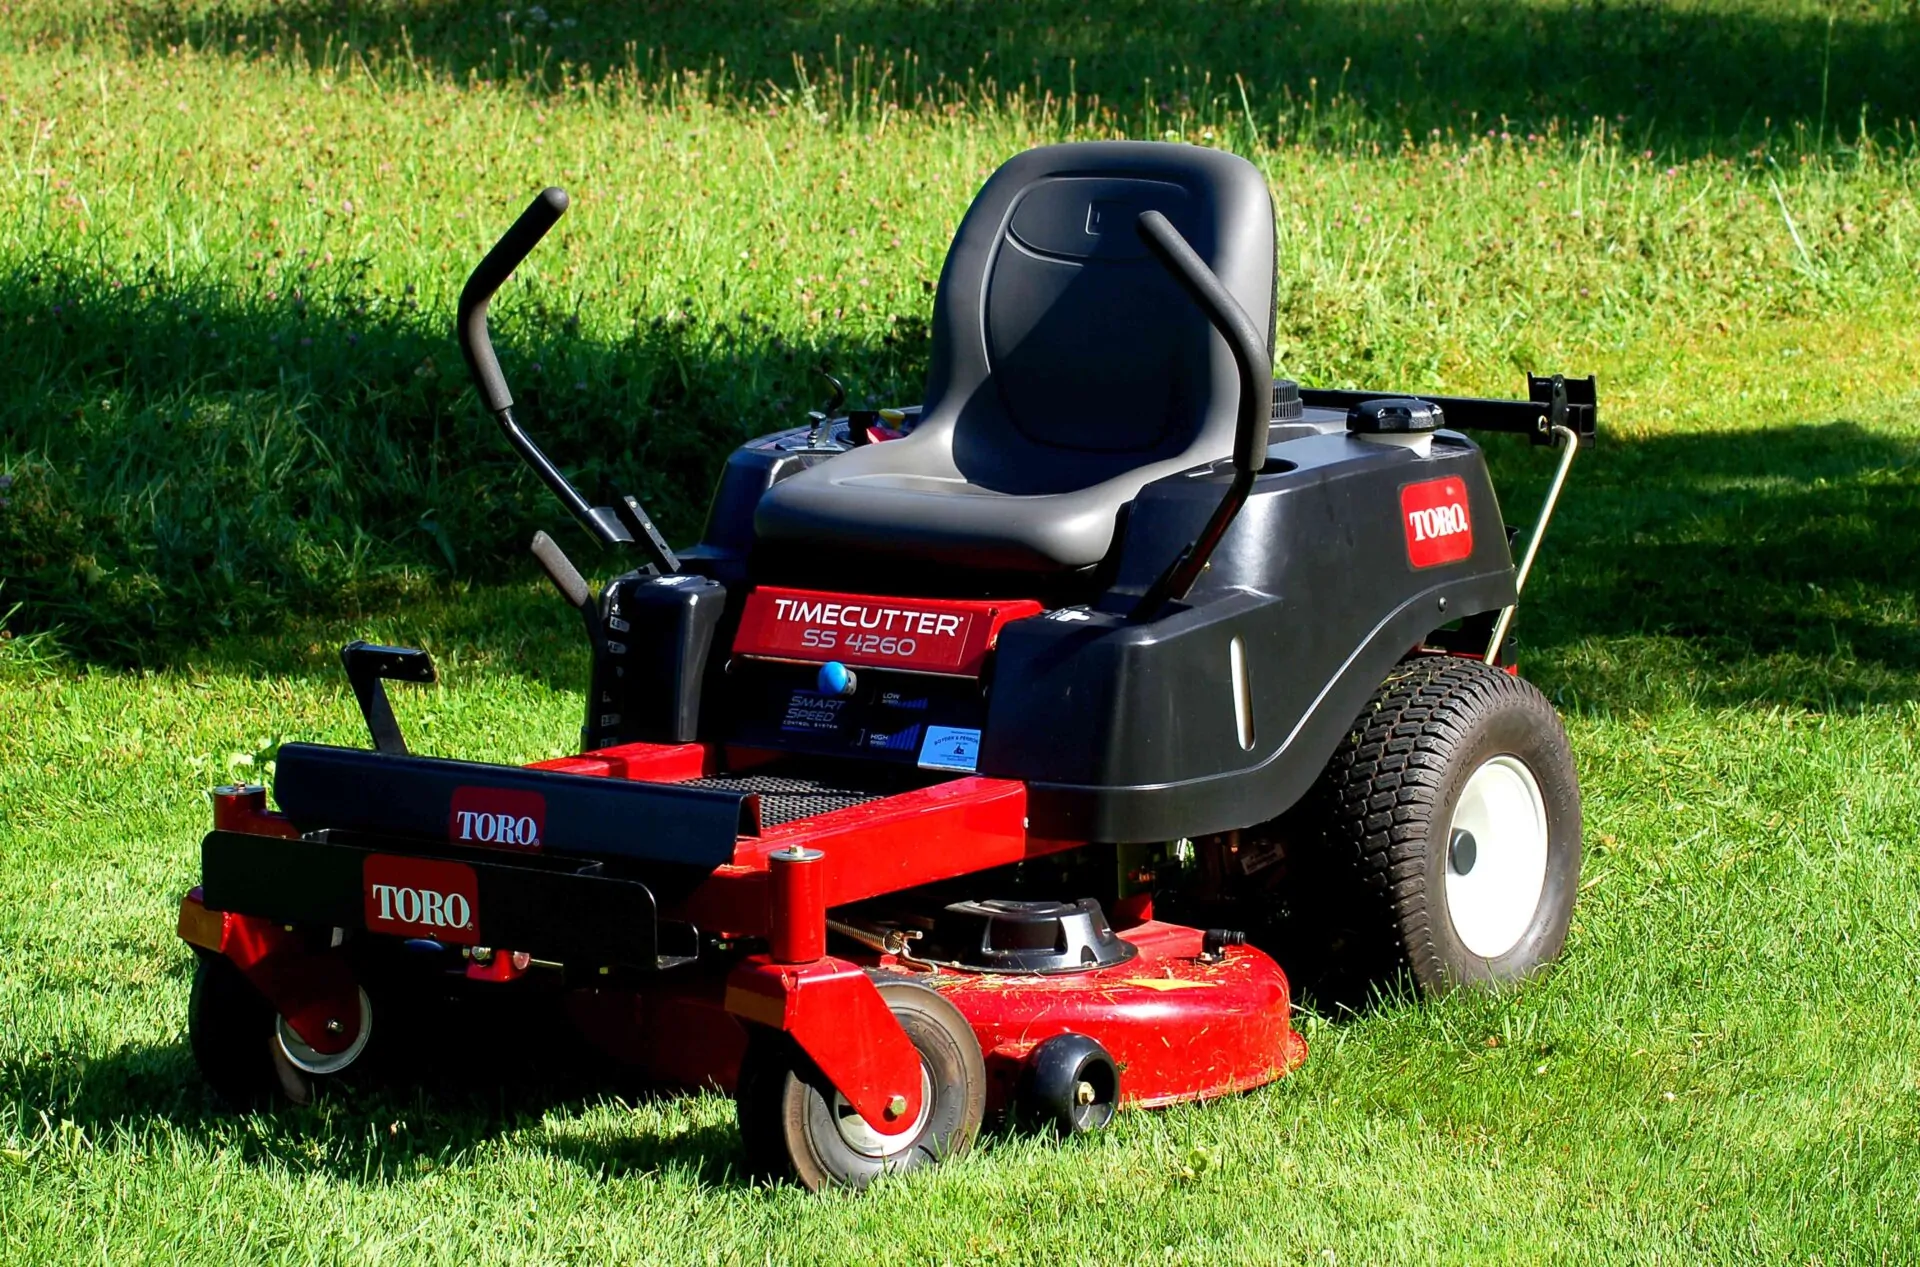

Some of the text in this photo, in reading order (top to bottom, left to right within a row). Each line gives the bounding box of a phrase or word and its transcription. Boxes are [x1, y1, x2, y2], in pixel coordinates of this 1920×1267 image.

[1408, 503, 1467, 542] TORO
[775, 598, 961, 637] TIMECUTTER
[801, 629, 916, 656] SS 4260
[787, 694, 847, 712] SMART
[881, 692, 901, 700] LOW
[784, 707, 835, 723] SPEED
[869, 733, 889, 741] HIGH
[457, 811, 537, 846] TORO
[372, 884, 471, 929] TORO
